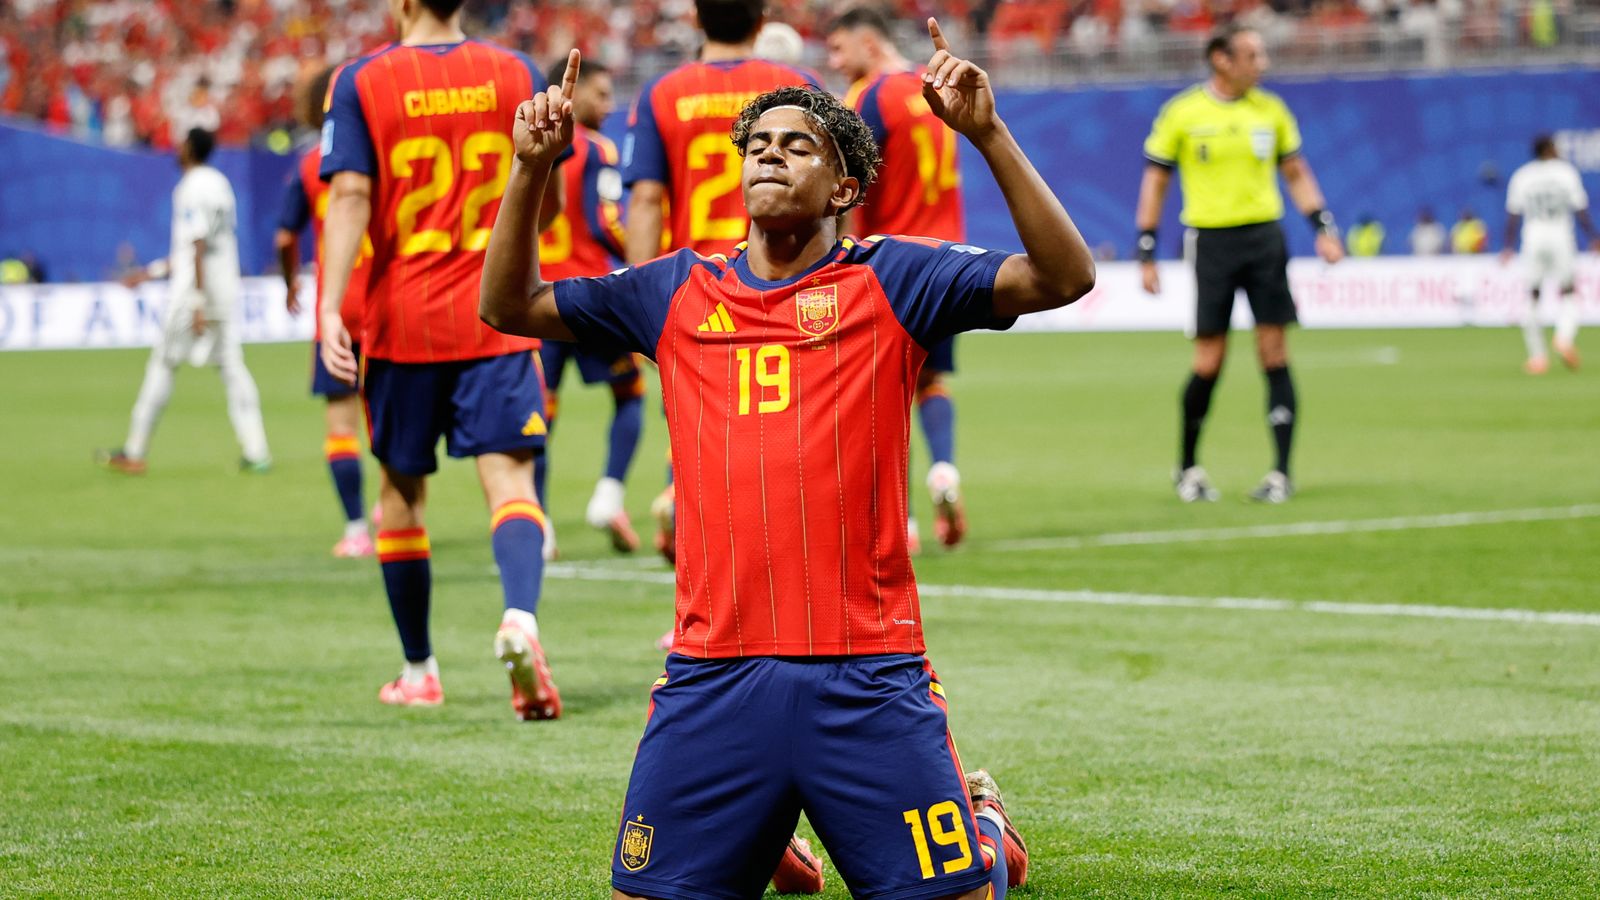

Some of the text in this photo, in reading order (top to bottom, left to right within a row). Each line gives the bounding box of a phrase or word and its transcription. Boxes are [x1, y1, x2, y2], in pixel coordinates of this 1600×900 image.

[390, 131, 513, 256] 22
[736, 344, 790, 416] 19
[903, 800, 973, 880] 19
